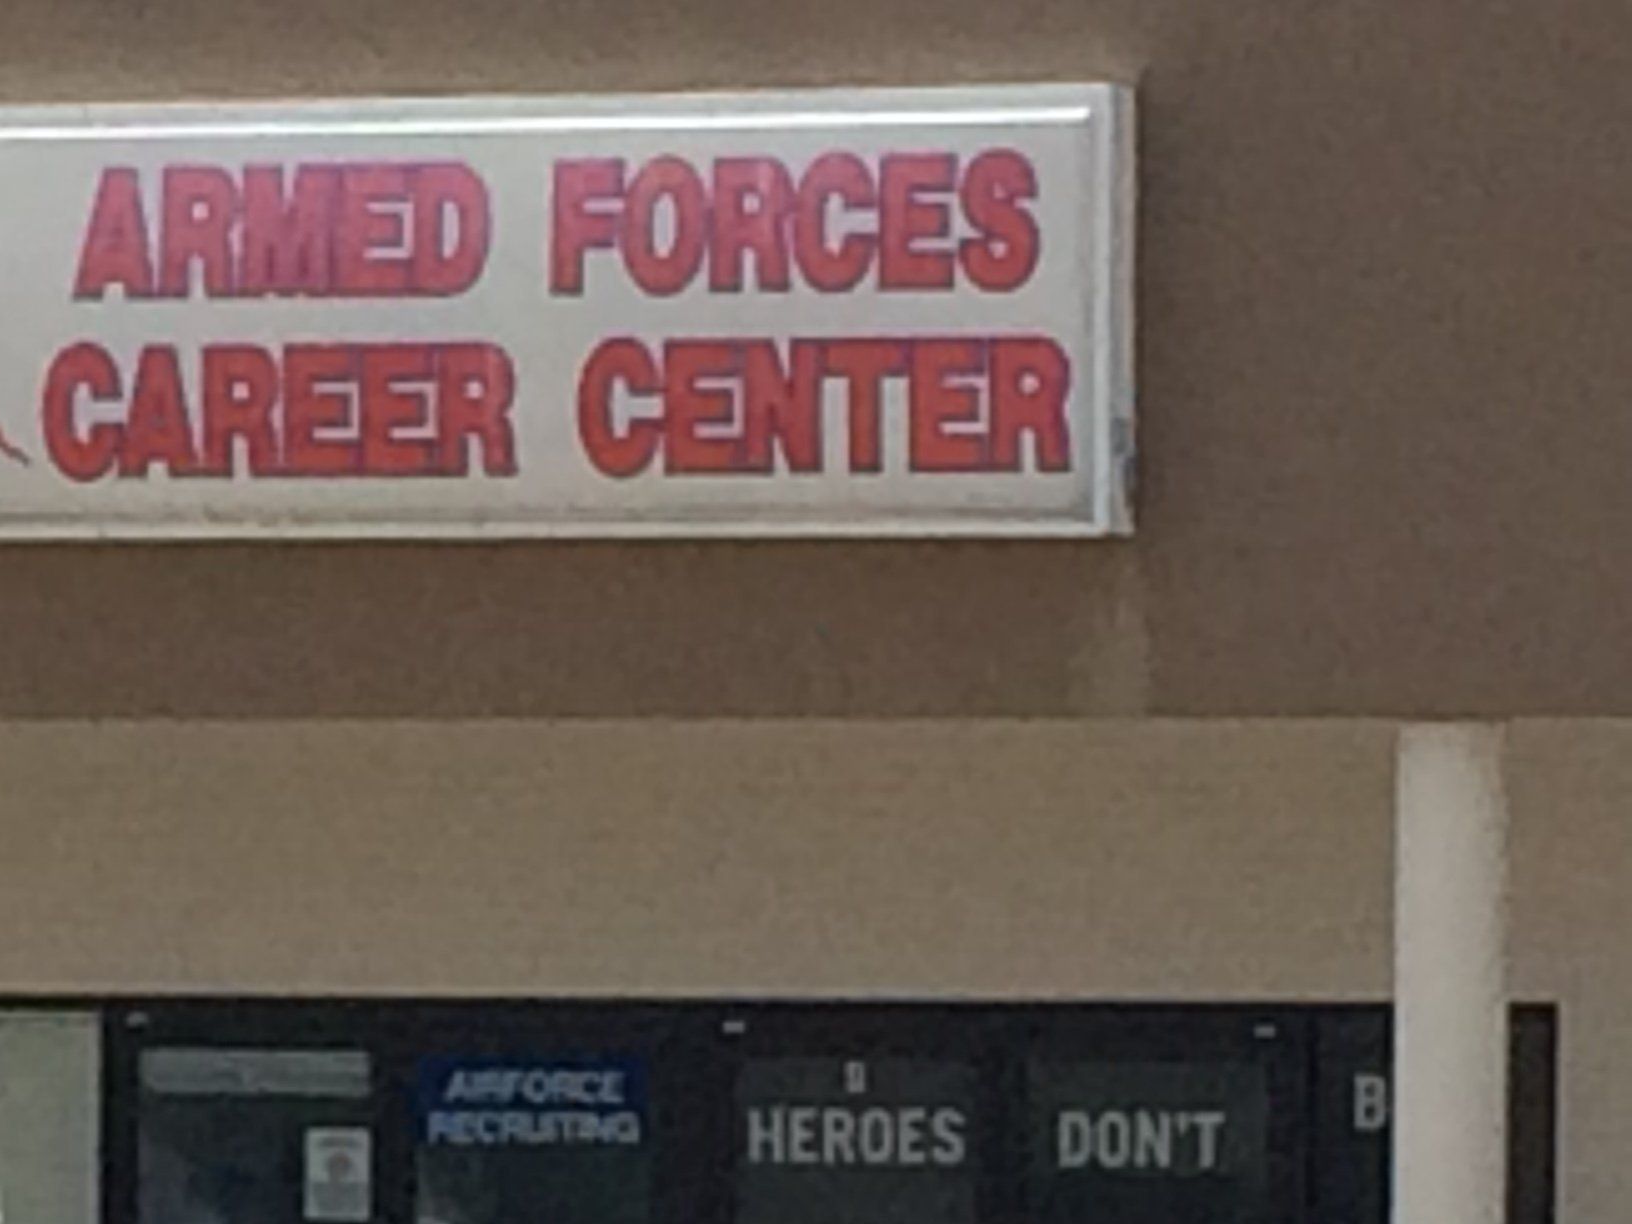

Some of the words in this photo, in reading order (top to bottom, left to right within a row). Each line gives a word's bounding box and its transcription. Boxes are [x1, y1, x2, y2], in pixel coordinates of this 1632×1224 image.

[71, 160, 491, 301] ARMED
[549, 147, 1041, 297] FORCES
[42, 340, 518, 482] CAREER
[577, 335, 1073, 479] CENTER
[443, 1069, 626, 1104] AIRFORCE
[427, 1111, 641, 1144] RECRUITING
[748, 1106, 967, 1164] HEROES
[1058, 1109, 1225, 1168] DON'T
